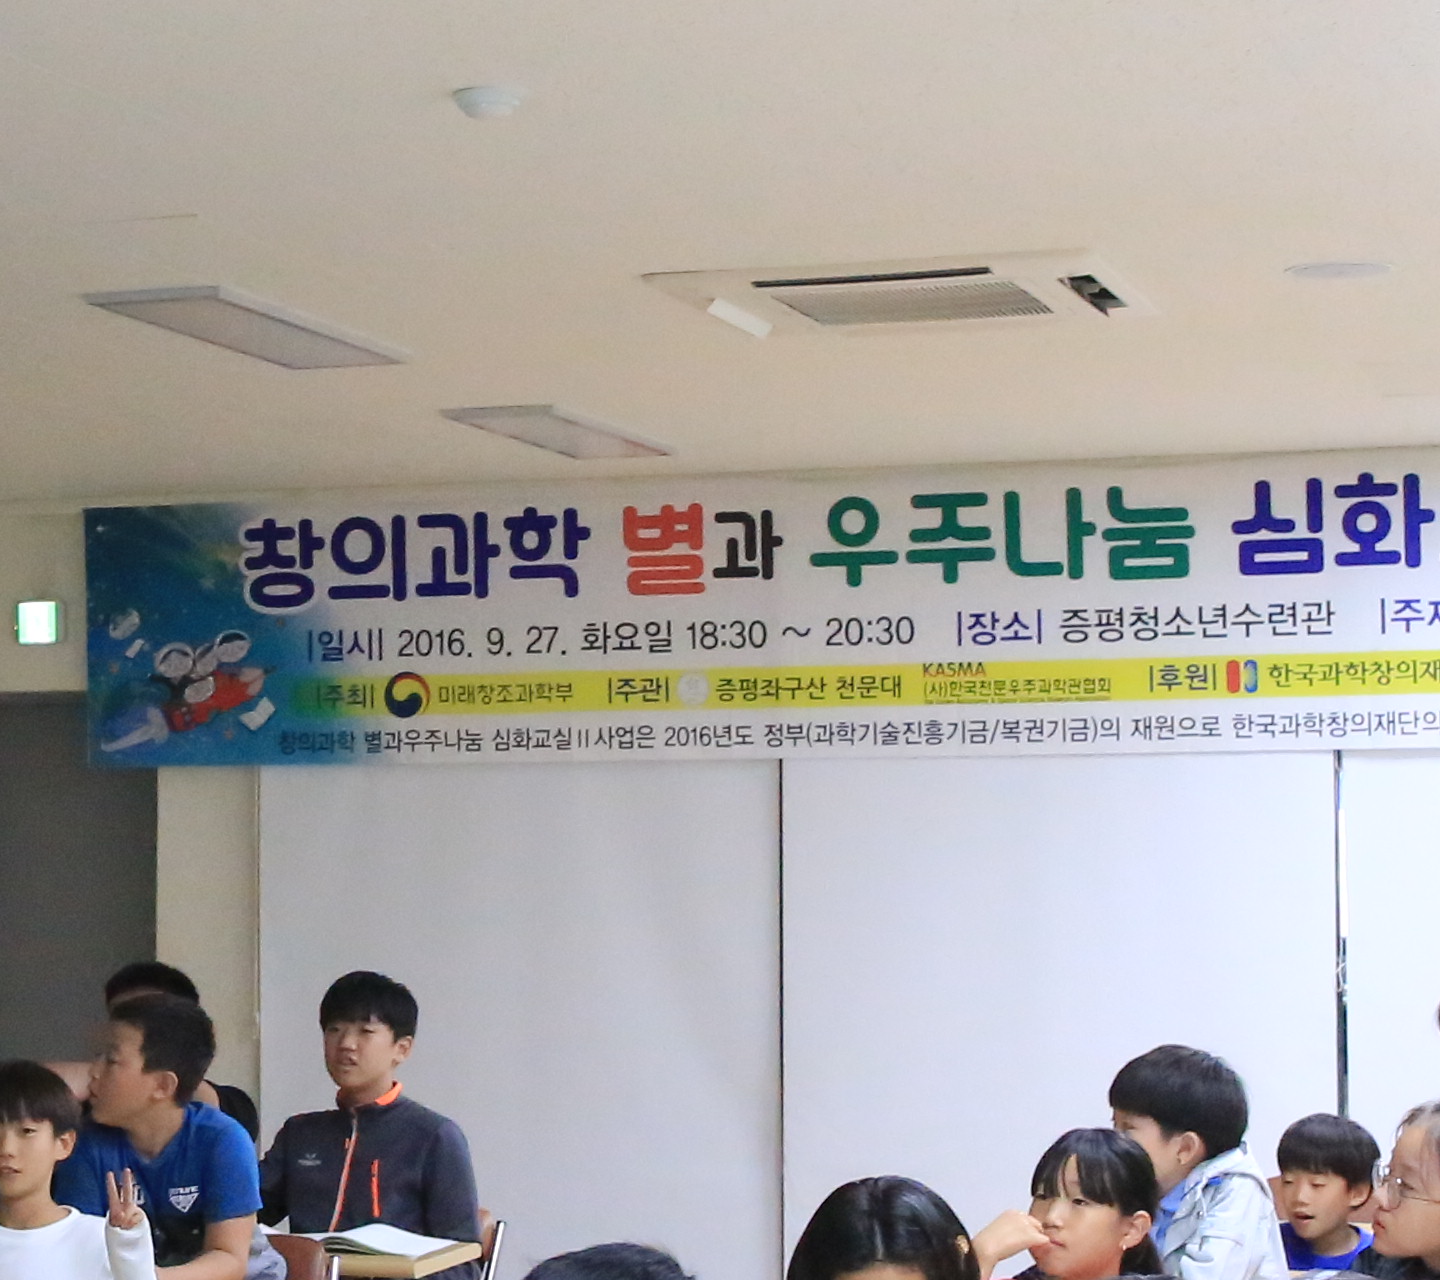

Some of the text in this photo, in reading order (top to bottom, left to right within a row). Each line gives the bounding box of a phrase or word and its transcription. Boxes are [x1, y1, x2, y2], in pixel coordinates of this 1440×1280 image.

[243, 506, 591, 608] 창의과학
[622, 502, 784, 597] 별과
[809, 486, 1196, 588] 우주나눔
[397, 628, 473, 658] 2016.
[486, 626, 512, 657] 9.
[525, 625, 567, 656] 27.
[580, 620, 673, 655] 화요일
[685, 619, 768, 650] 18:30
[825, 615, 916, 647] 20:30
[1059, 600, 1336, 643] 증평청소년수련관
[715, 676, 827, 702] 증평좌구산
[835, 673, 902, 700] 천문대
[922, 661, 988, 679] KASMA
[438, 682, 574, 705] 미래창조과학부
[278, 730, 356, 756] 창의과학
[364, 728, 483, 754] 별과우주나눔
[594, 723, 656, 750] 사업은
[664, 723, 754, 748] 2016년도
[1130, 714, 1223, 741] 재원으로
